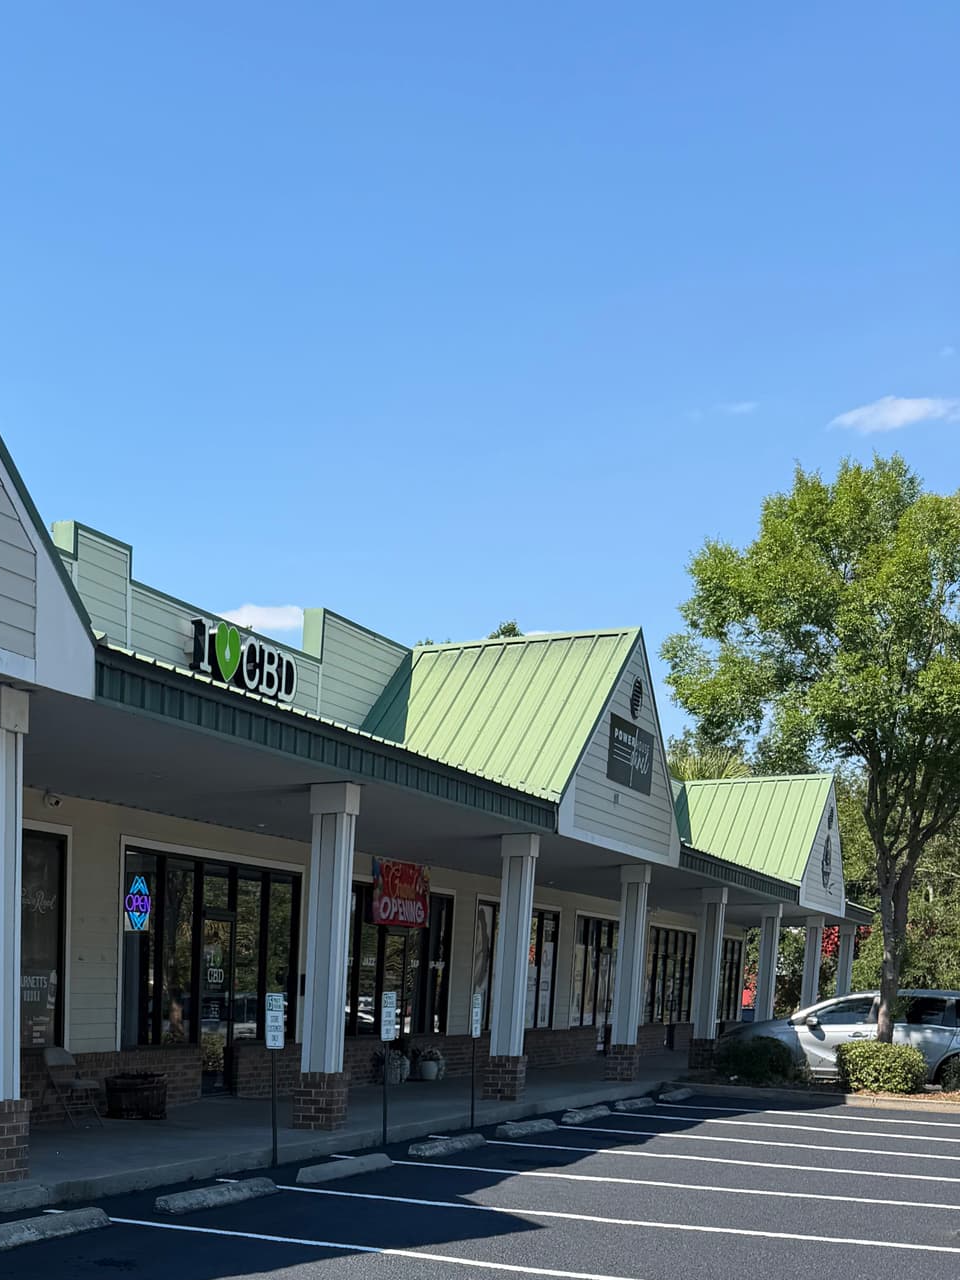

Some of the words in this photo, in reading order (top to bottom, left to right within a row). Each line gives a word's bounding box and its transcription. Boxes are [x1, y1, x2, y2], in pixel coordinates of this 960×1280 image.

[191, 616, 214, 673] I
[242, 636, 298, 703] CBD
[125, 894, 151, 913] OPEN
[380, 896, 425, 923] OPENING
[207, 968, 225, 984] CBD
